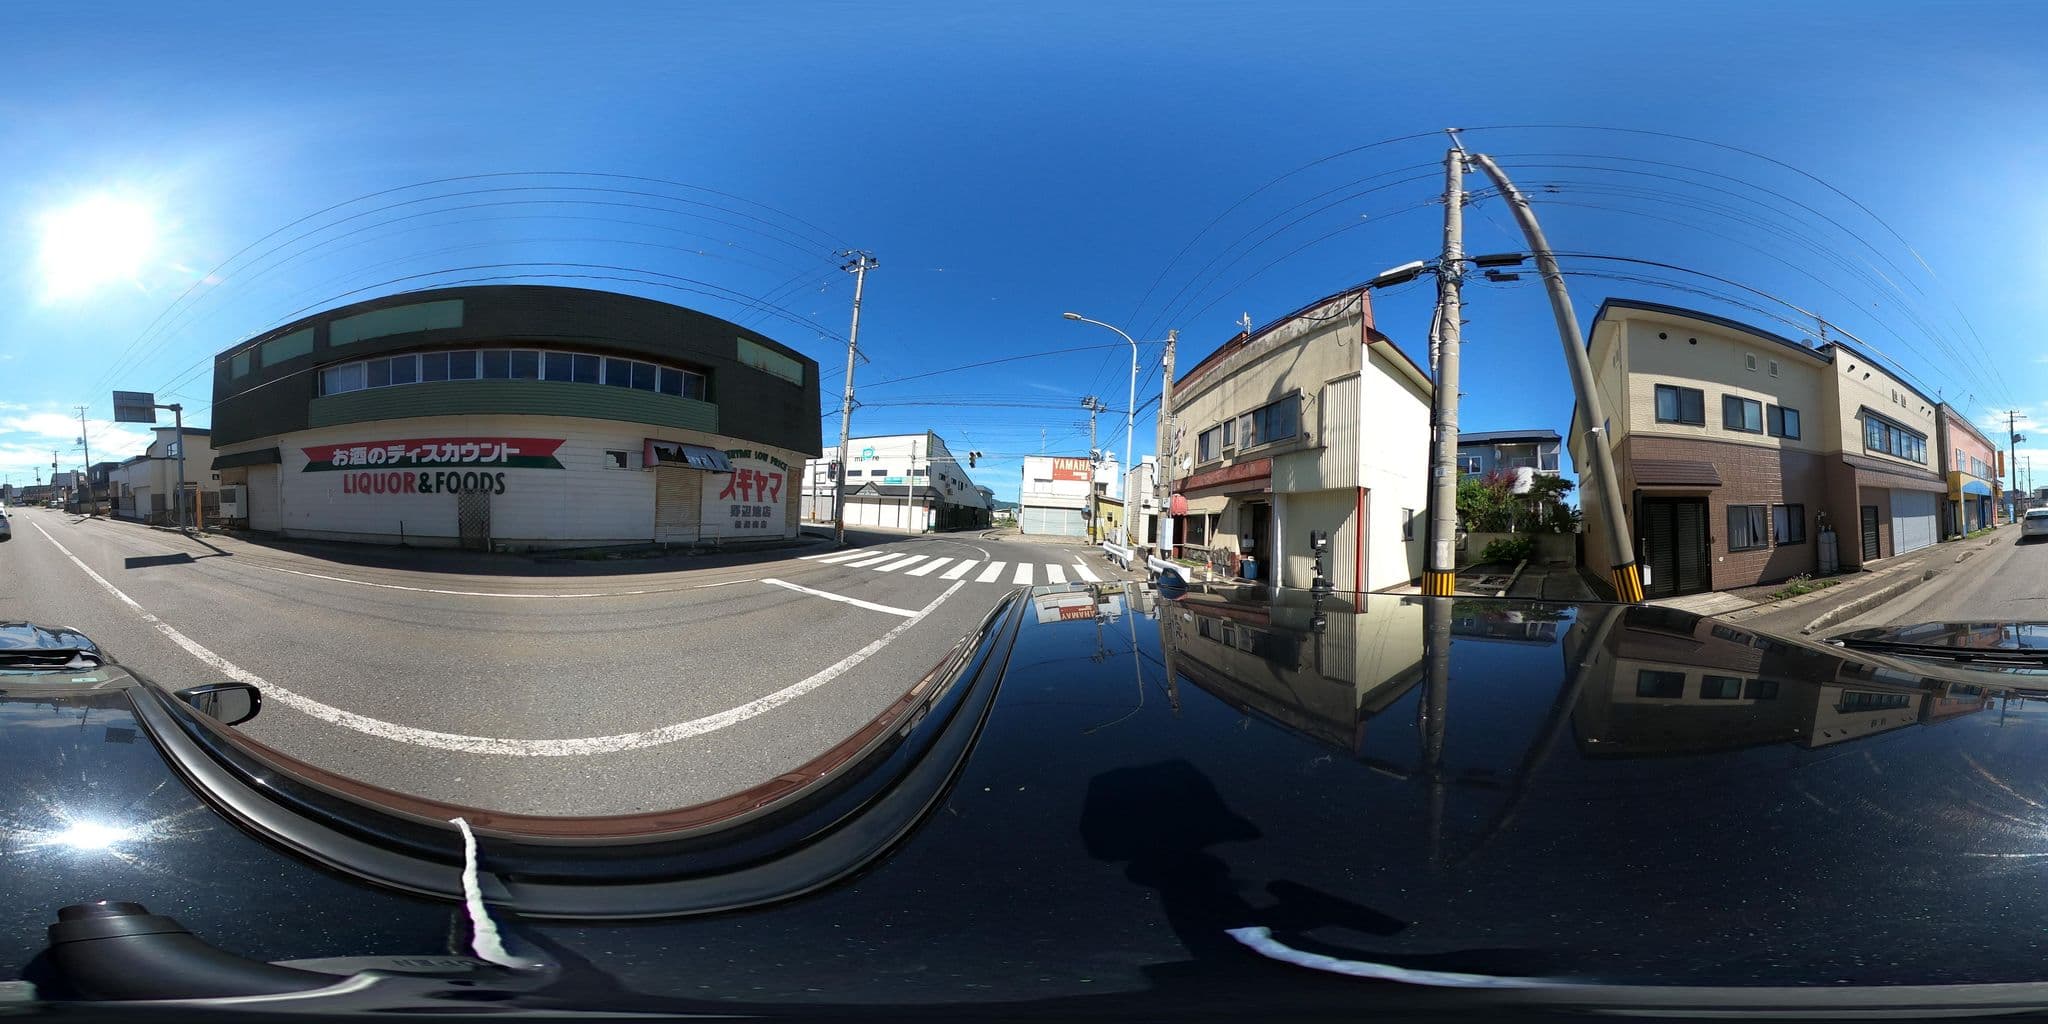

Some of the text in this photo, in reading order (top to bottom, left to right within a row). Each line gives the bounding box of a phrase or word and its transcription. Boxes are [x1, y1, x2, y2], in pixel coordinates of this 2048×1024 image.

[332, 441, 520, 466] お酒のディスカウント
[755, 451, 769, 462] LOW
[770, 456, 788, 472] PRICE
[1054, 459, 1091, 472] YAMAHA
[343, 471, 506, 495] LIQUOR&FOODS
[719, 467, 783, 503] スギヤマ
